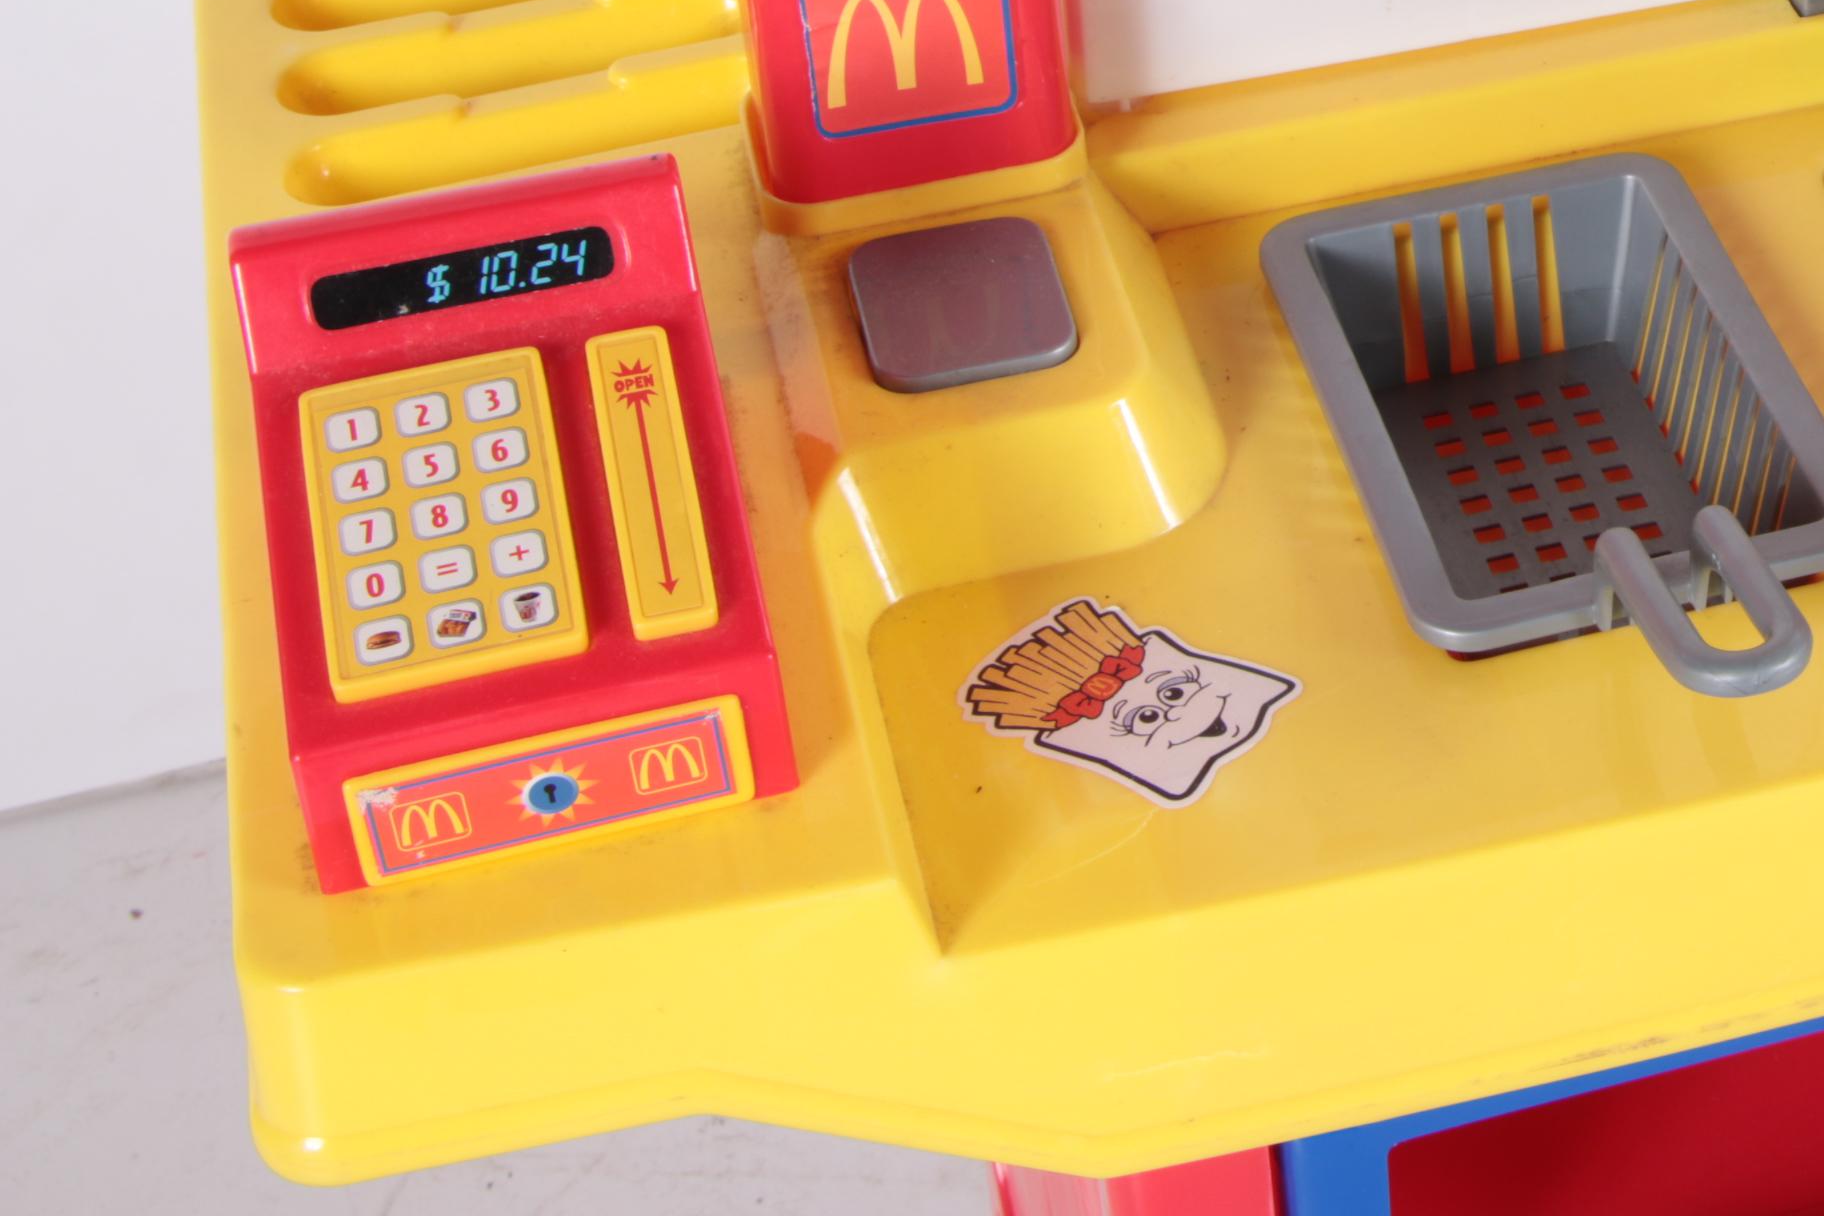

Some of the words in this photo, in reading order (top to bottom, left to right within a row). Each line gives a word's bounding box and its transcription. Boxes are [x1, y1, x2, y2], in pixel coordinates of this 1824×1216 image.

[478, 239, 588, 295] 10.24
[613, 372, 656, 394] OPEN
[347, 418, 358, 441] 1
[415, 404, 430, 427] 2
[486, 390, 500, 412] 3
[350, 468, 369, 492] 4
[424, 453, 440, 478] 5
[491, 438, 509, 463] 6
[359, 520, 375, 545] 7
[431, 504, 449, 529] 8
[501, 488, 519, 513] 9
[365, 573, 385, 598] 0
